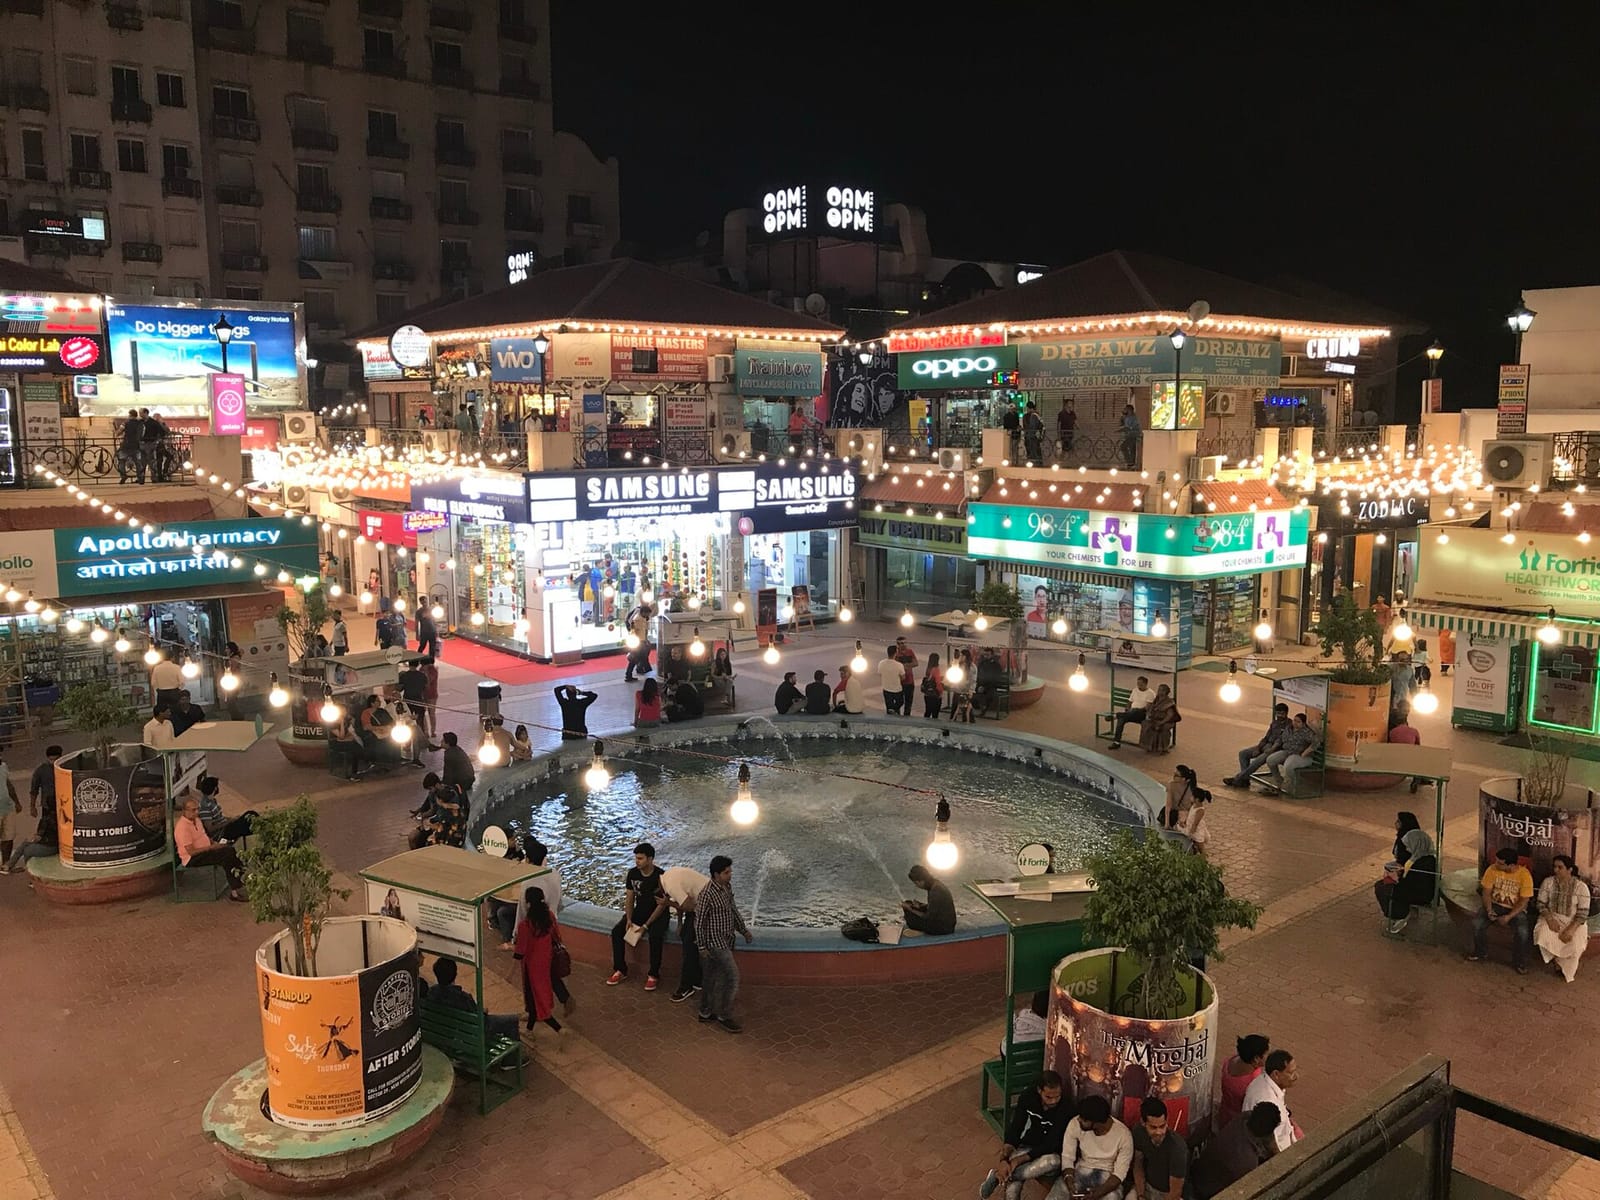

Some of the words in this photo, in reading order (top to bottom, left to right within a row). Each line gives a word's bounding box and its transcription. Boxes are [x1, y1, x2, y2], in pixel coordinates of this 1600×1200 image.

[135, 320, 155, 332] Do
[158, 321, 206, 337] bigger
[8, 337, 38, 352] Color
[40, 338, 60, 352] Lab
[612, 336, 655, 349] MOBILE
[655, 337, 705, 350] MASTERS
[1040, 339, 1157, 361] DREAMZ
[1194, 340, 1272, 359] DREAMZ
[748, 357, 813, 377] Rainbow
[1068, 358, 1124, 369] ESTATE
[1215, 357, 1252, 368] ESTATE
[586, 473, 710, 502] SAMSUNG
[756, 474, 856, 501] SAMSUNG
[660, 504, 692, 514] DEALER
[1358, 498, 1416, 520] ZODIAC
[861, 518, 887, 535] MY
[888, 519, 963, 544] DENTIST
[78, 531, 167, 556] Apollo
[167, 530, 281, 548] Pharmacy
[0, 555, 33, 570] ollo
[1045, 550, 1066, 559] YOUR
[1067, 552, 1102, 563] CHEMISTS
[1121, 558, 1137, 568] FOR
[1138, 559, 1153, 568] LIFE
[1481, 682, 1495, 691] OFF
[294, 726, 323, 736] ESTIVE
[73, 829, 97, 838] AFTER
[98, 825, 134, 837] STORIES
[1490, 808, 1555, 839] Mughal
[1028, 857, 1049, 867] Fortis
[270, 988, 312, 1004] STANDUP
[367, 1048, 400, 1074] AFTER
